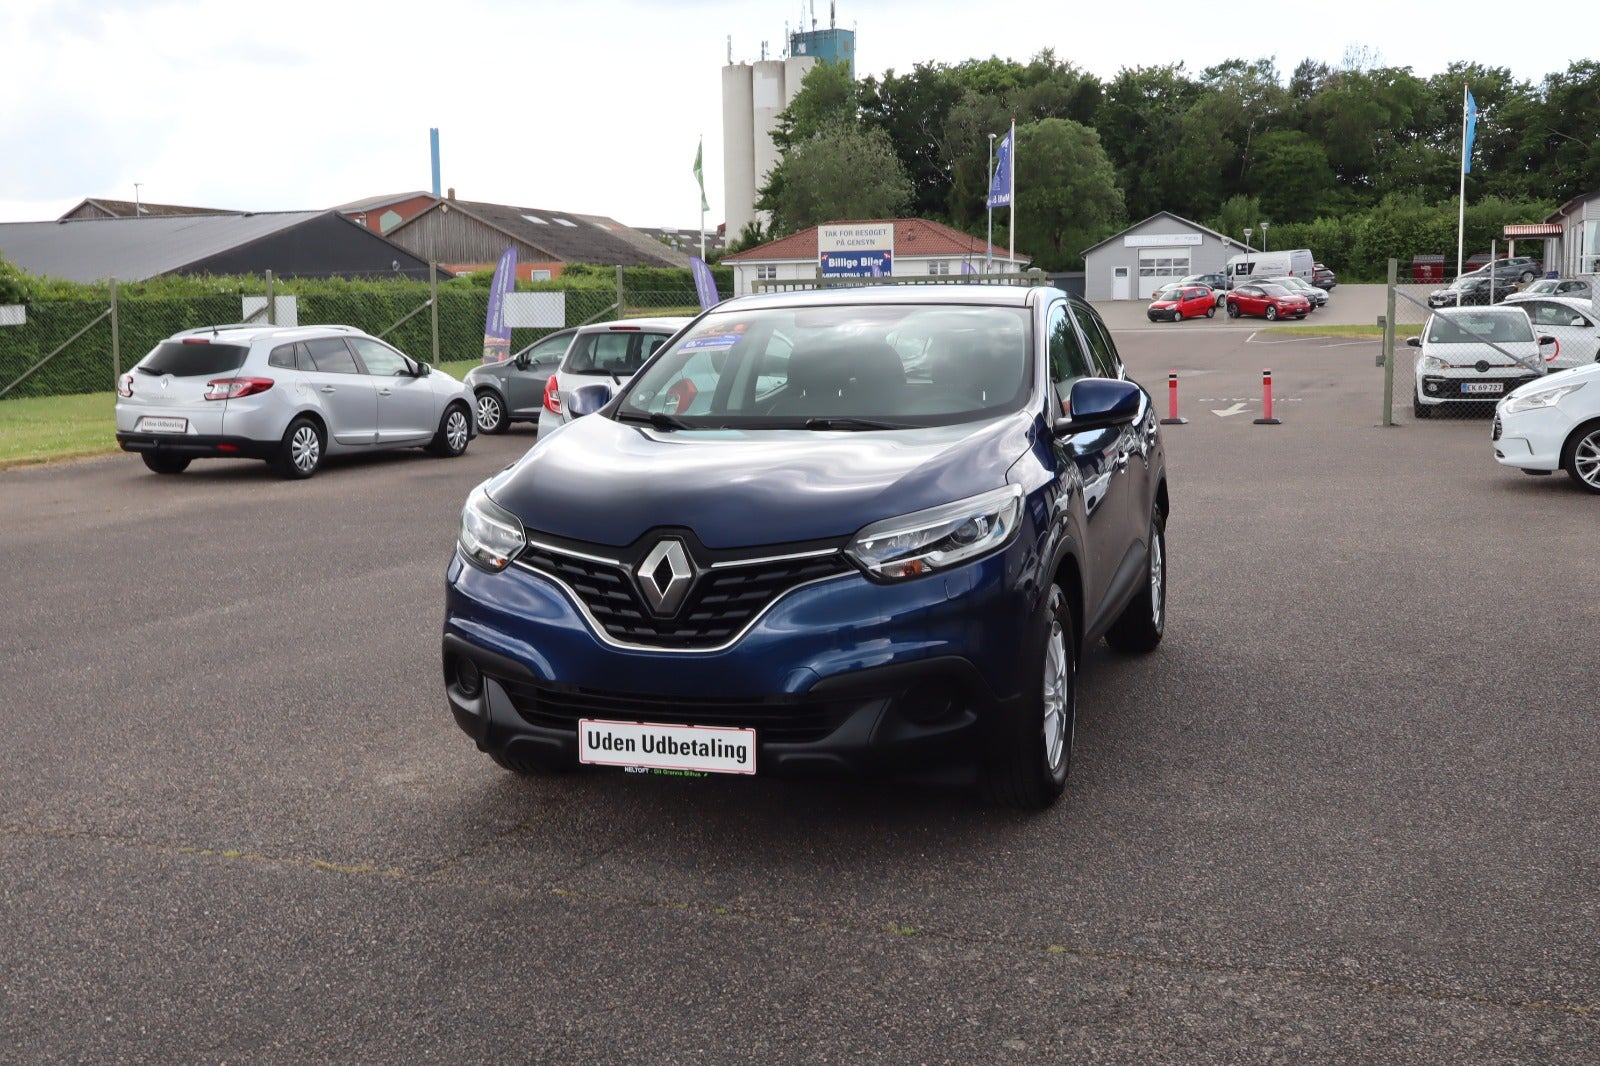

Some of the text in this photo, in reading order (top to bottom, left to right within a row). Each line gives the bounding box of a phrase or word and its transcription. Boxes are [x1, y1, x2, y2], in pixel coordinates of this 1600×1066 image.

[828, 257, 884, 269] Billige Biler
[587, 730, 747, 764] Uden Udbetaling
